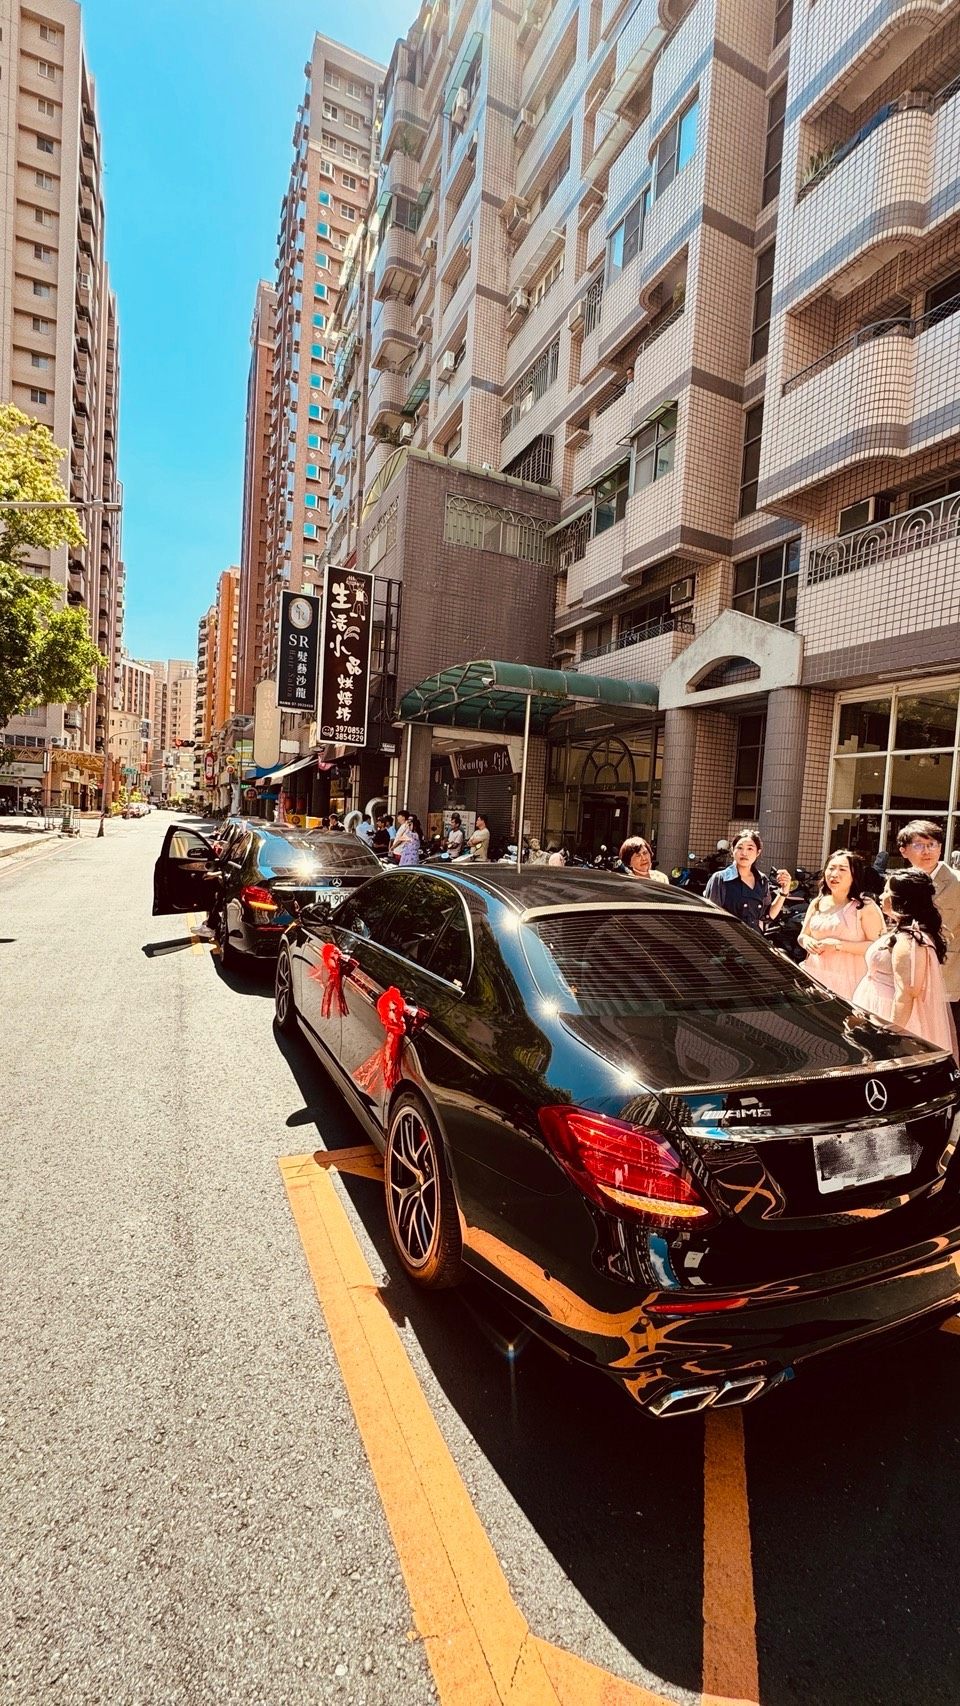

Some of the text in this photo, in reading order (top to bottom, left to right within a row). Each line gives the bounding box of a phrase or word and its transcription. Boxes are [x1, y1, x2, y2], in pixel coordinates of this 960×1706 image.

[288, 633, 310, 648] SR
[295, 650, 309, 699] 髮藝沙龍
[287, 671, 295, 697] Salon
[334, 732, 364, 743] 3854229
[335, 725, 364, 735] 3970852
[492, 751, 510, 773] Life
[724, 1108, 772, 1119] AMG
